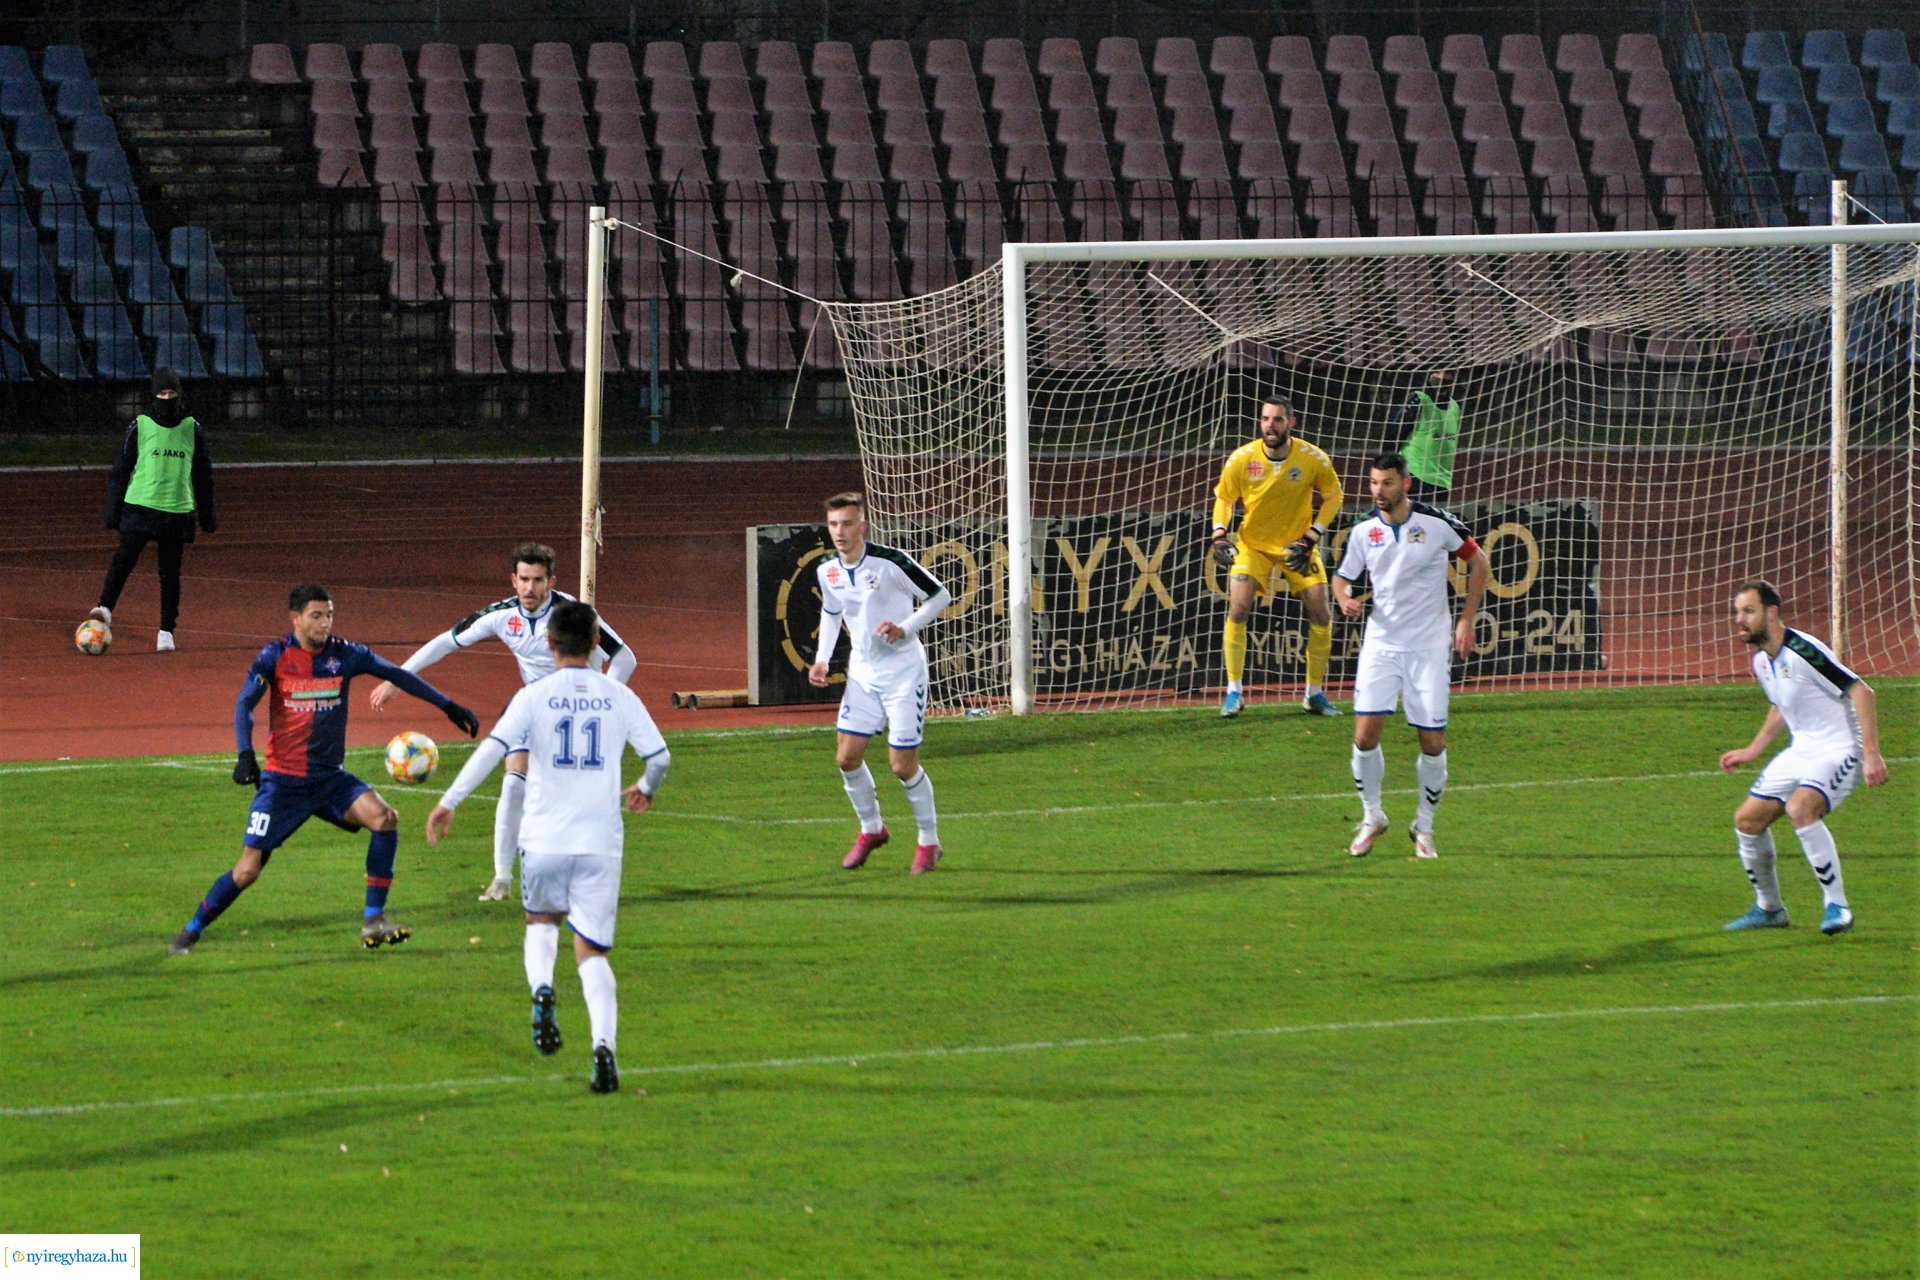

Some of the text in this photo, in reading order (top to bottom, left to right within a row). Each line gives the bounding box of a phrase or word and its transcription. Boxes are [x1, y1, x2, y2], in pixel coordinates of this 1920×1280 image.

[163, 449, 185, 458] JAKO
[939, 626, 1199, 677] NYÍEGYHÁZA
[1249, 621, 1306, 666] YÍR
[548, 697, 612, 714] GAJDOS
[841, 705, 850, 720] 2
[553, 716, 604, 770] 11
[247, 811, 271, 836] 30
